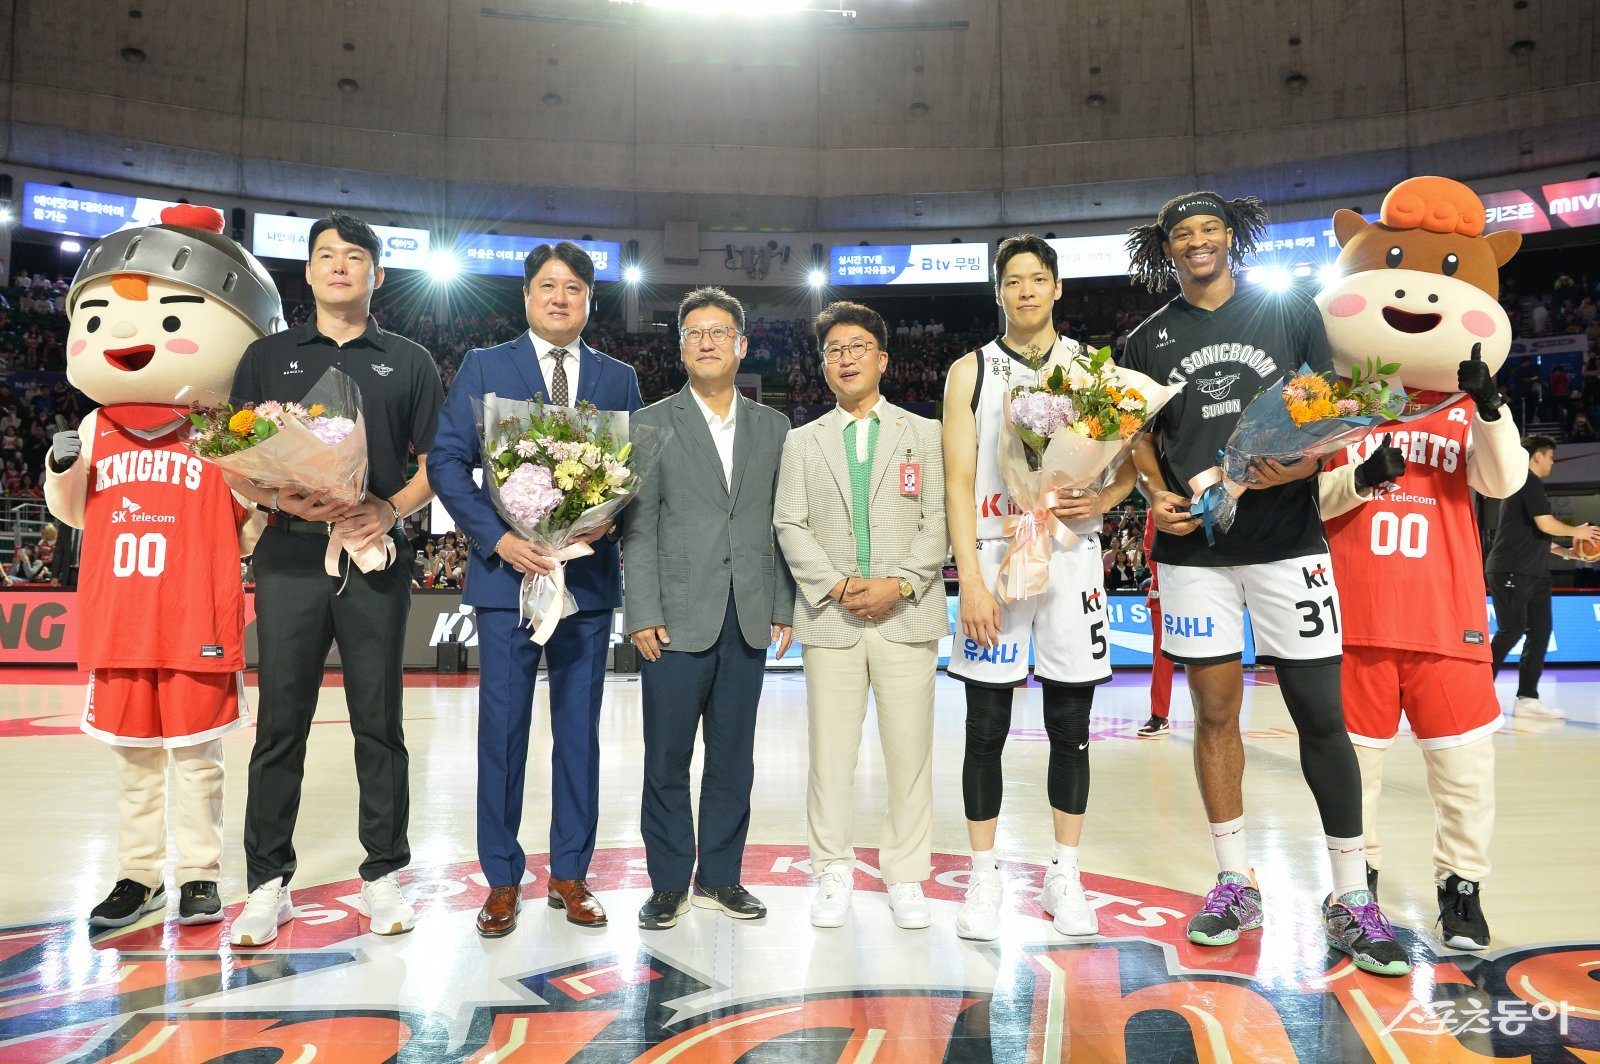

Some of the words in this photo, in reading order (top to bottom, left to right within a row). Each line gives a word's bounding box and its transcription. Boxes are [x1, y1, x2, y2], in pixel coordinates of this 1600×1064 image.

[267, 231, 296, 243] 나만의
[838, 255, 862, 265] 실시간
[954, 257, 980, 271] 무빙
[1180, 343, 1278, 379] SONICBOOM
[1202, 399, 1241, 419] SUWON
[1346, 431, 1461, 473] KNGHTS
[96, 449, 203, 491] KNIGHTS
[1390, 492, 1436, 505] telecom
[111, 511, 127, 524] SK
[132, 512, 176, 523] telecom
[1371, 511, 1428, 558] 00
[113, 532, 167, 577] 00
[1302, 564, 1328, 590] kt
[1081, 588, 1101, 615] kt
[1164, 613, 1215, 637] 유사나
[1295, 595, 1339, 638] 31
[964, 638, 1018, 664] 유사나
[1090, 620, 1107, 660] 5
